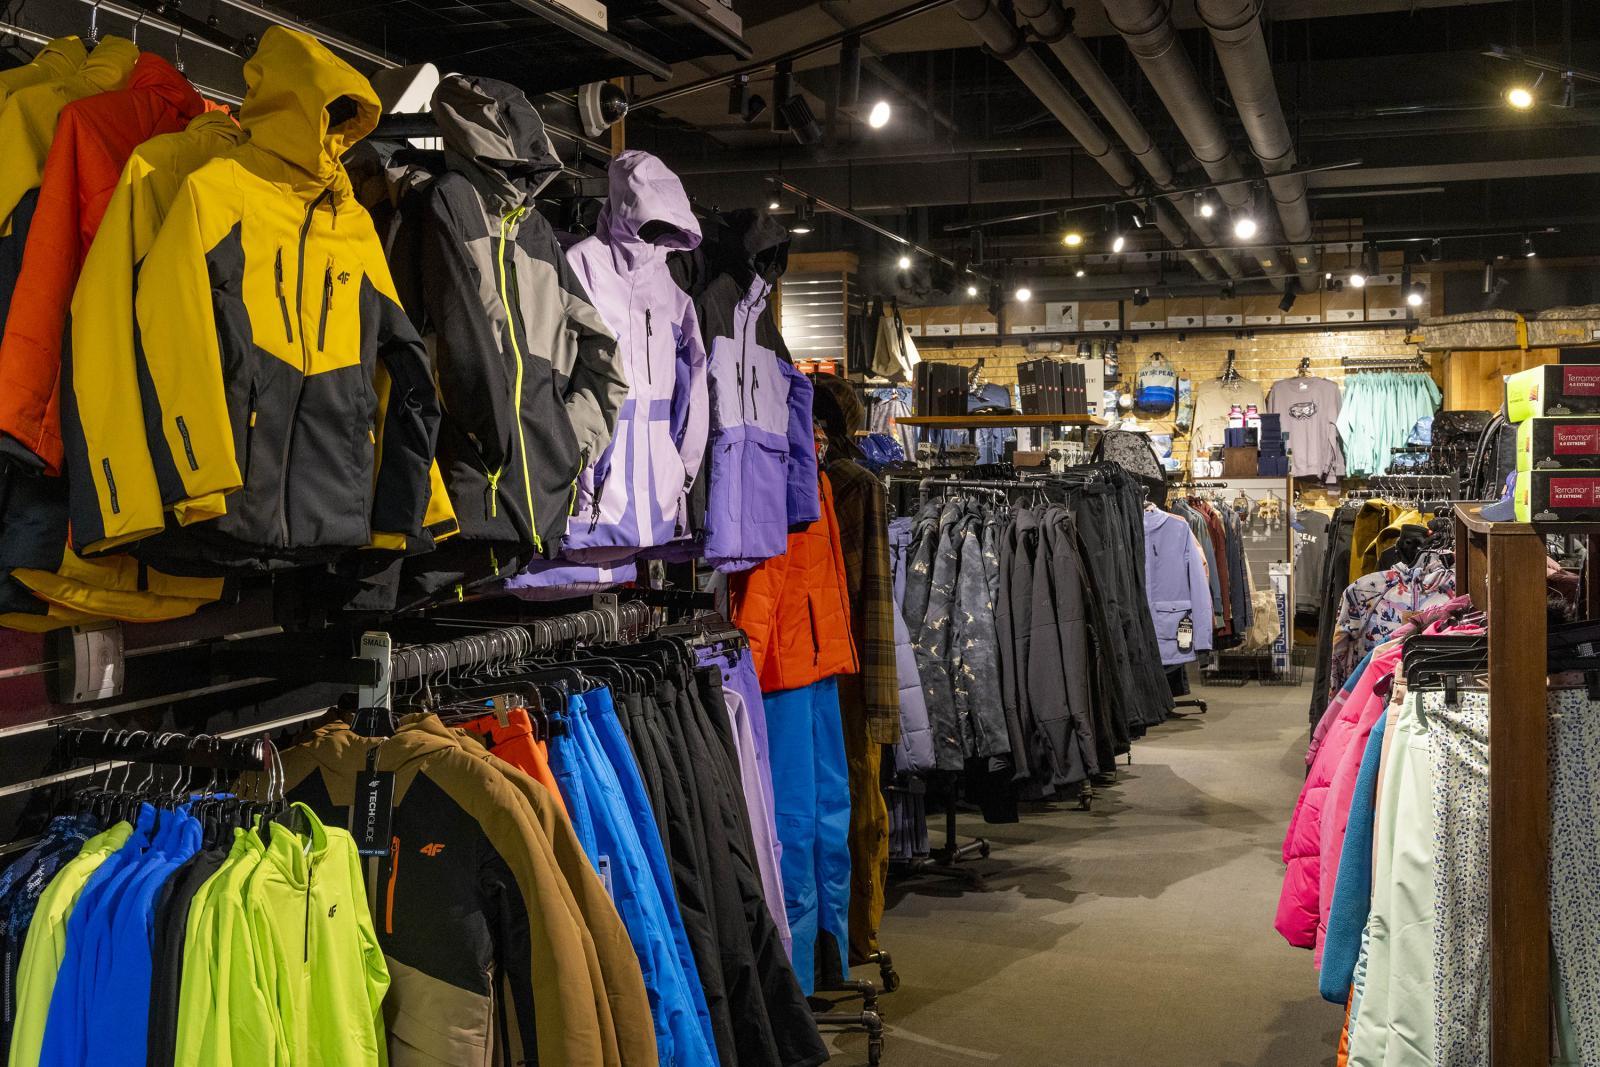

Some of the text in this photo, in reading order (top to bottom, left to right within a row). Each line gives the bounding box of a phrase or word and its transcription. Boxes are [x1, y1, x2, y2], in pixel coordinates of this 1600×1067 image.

[337, 270, 350, 285] 4F
[600, 595, 612, 605] XL
[362, 637, 388, 648] SMALL
[420, 842, 446, 857] 4F
